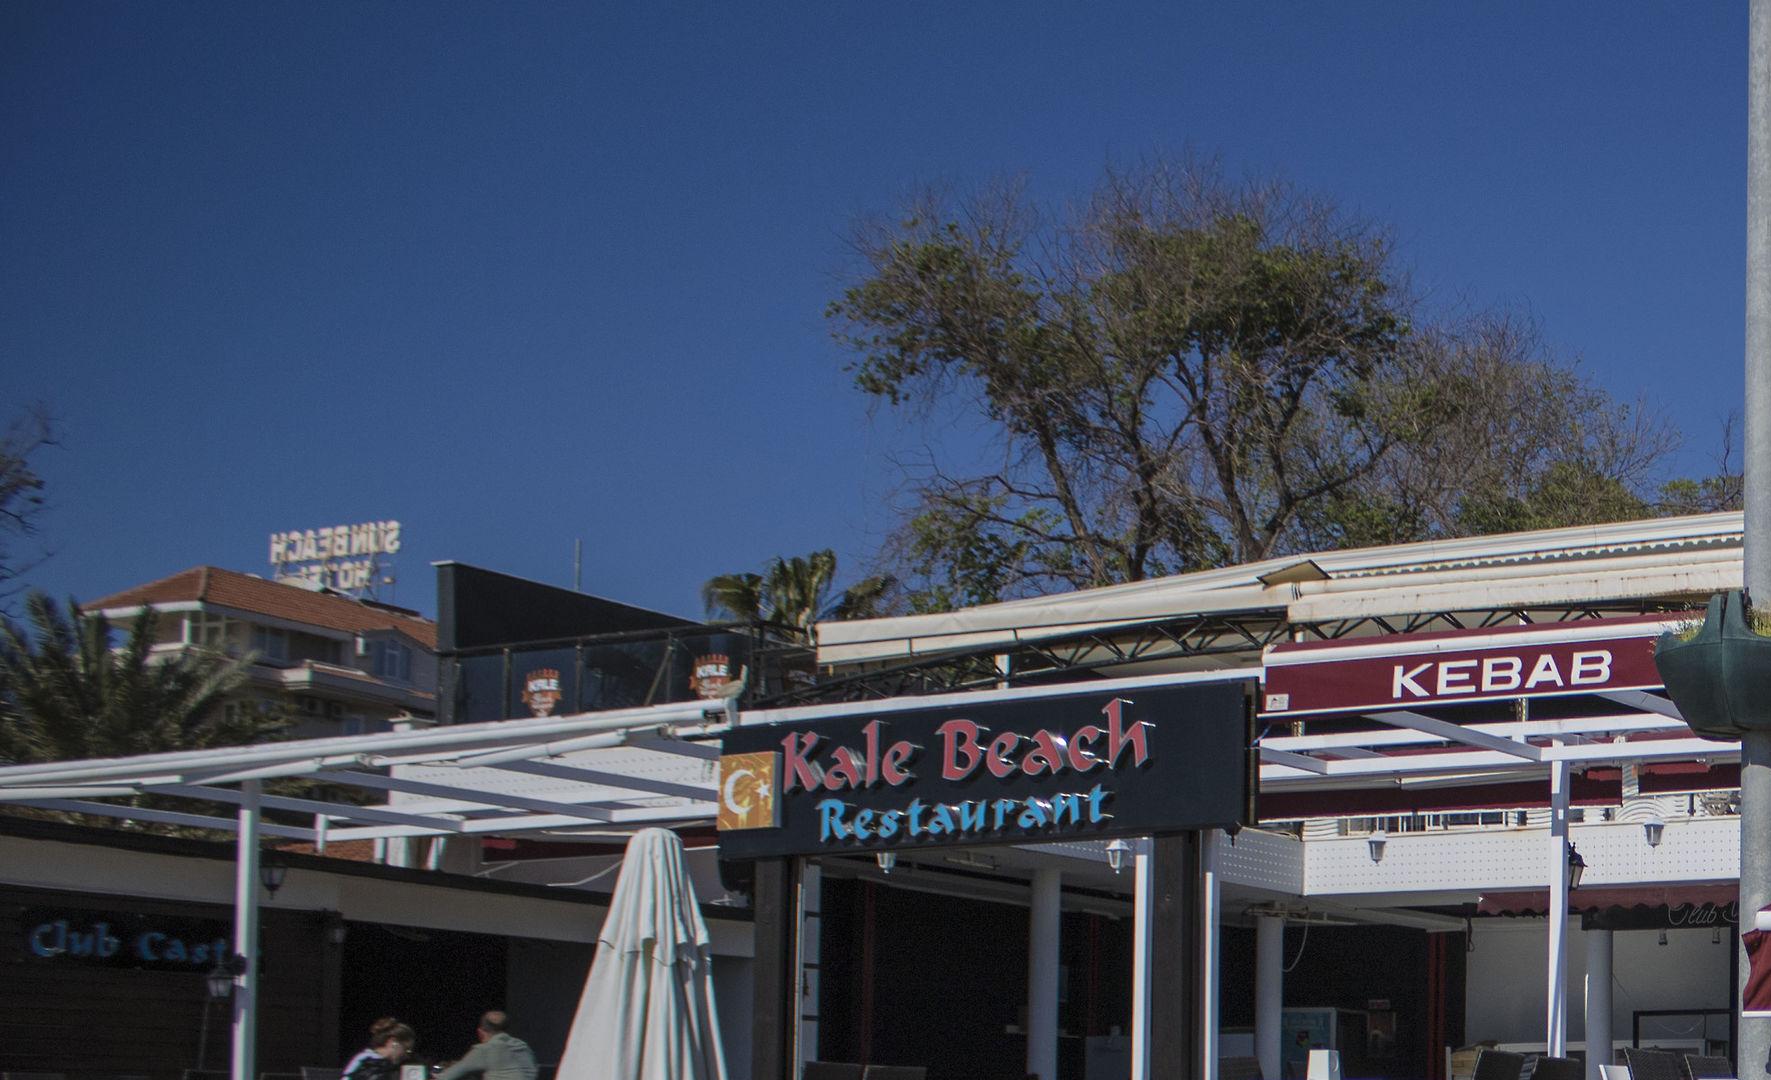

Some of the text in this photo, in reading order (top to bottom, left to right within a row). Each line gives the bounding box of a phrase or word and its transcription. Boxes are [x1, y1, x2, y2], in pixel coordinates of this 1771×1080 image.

[1391, 649, 1613, 699] KEBAB
[781, 697, 1153, 795] Kale Beach
[814, 782, 1112, 843] Restaurant
[31, 918, 230, 965] Club Cast
